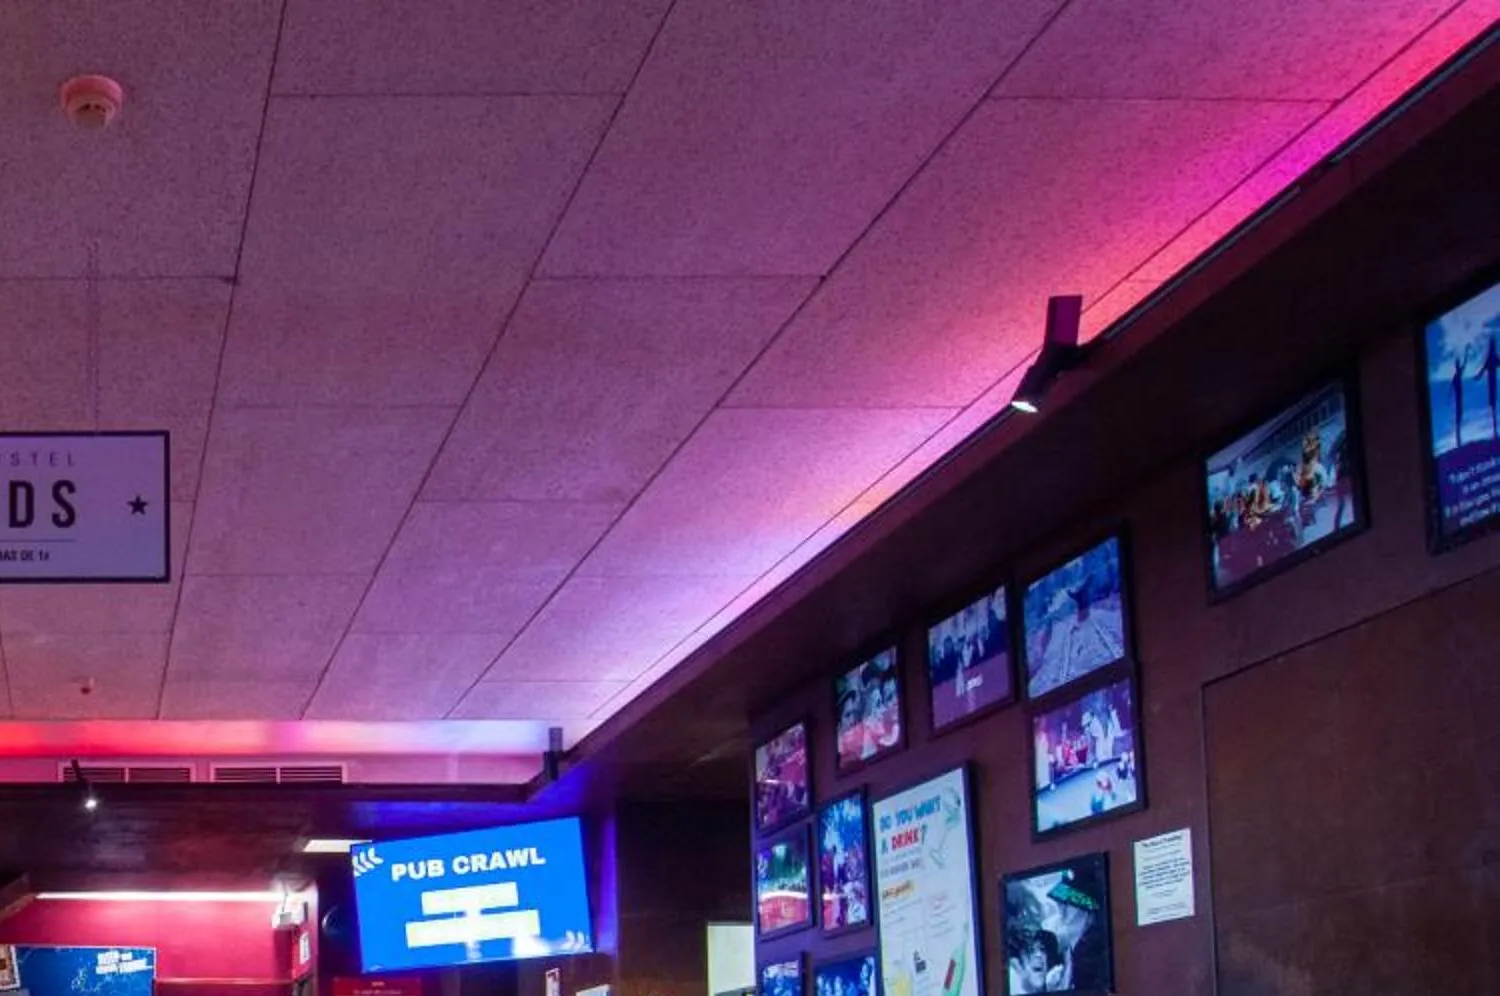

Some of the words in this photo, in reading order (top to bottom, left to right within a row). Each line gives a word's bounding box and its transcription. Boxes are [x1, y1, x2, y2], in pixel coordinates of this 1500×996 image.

[896, 809, 913, 826] YOU
[391, 859, 445, 882] PUB
[452, 847, 547, 875] CRAWL
